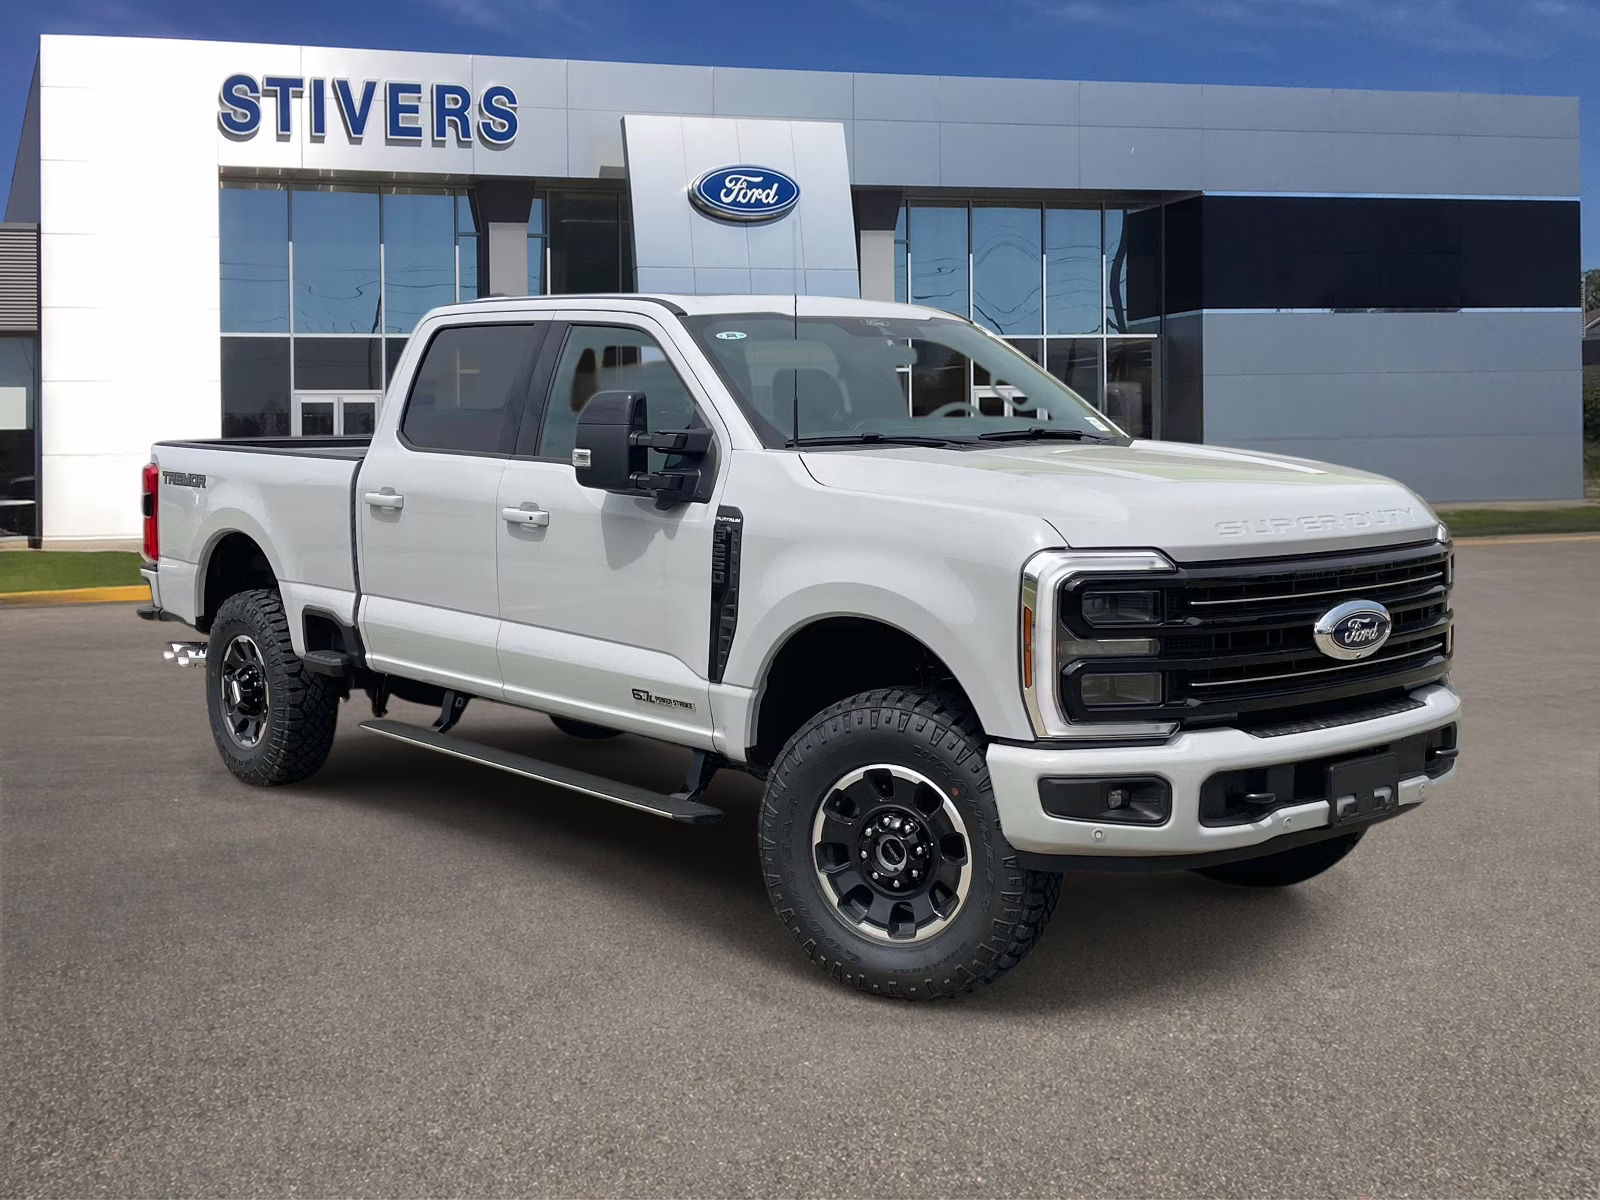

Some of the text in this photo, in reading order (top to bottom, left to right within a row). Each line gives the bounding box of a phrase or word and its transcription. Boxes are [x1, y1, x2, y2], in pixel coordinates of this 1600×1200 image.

[218, 73, 519, 146] STIVERS
[720, 174, 779, 204] Ford
[162, 470, 207, 489] TREMOR
[1214, 507, 1416, 537] SUPER DUTY
[1344, 617, 1379, 644] Ford
[631, 688, 693, 710] 6.7L POWER STROKE
